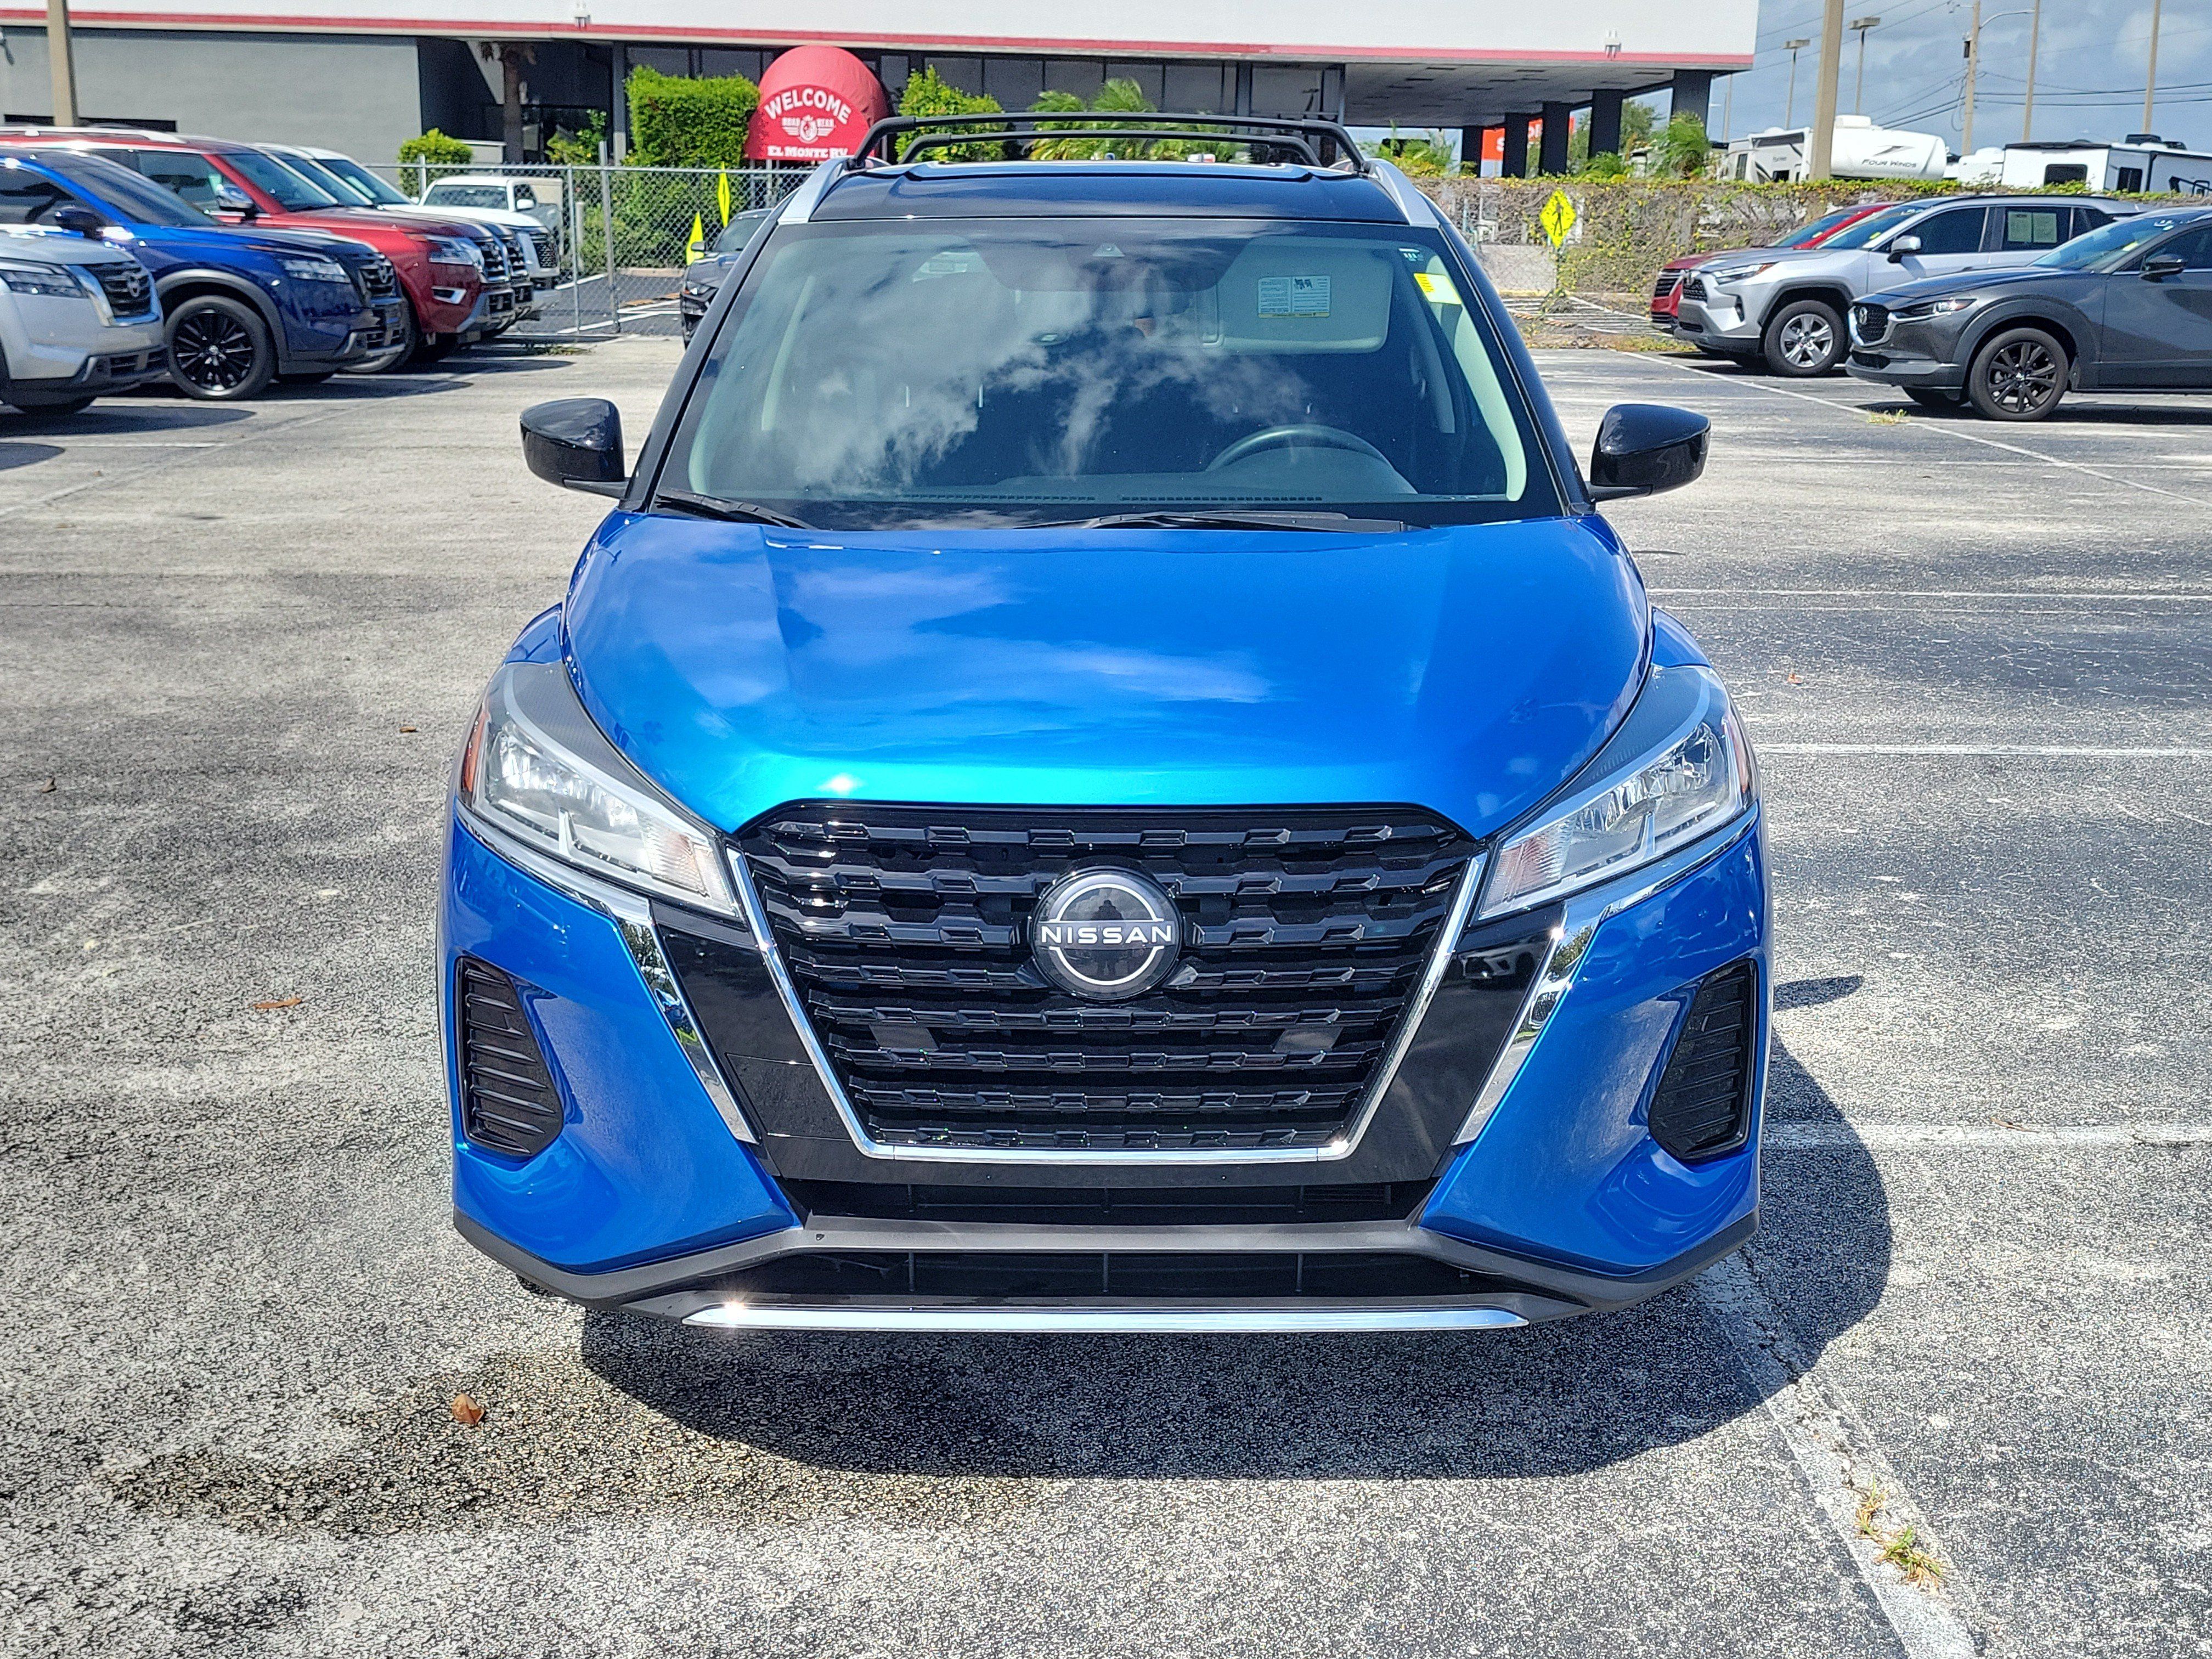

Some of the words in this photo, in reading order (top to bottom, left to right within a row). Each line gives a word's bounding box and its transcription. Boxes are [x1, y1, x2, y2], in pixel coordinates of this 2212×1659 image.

[764, 88, 851, 125] WELCOME
[767, 145, 783, 156] EL
[785, 146, 828, 158] MONTE
[829, 147, 849, 159] RV
[1041, 925, 1172, 944] NISSAN
